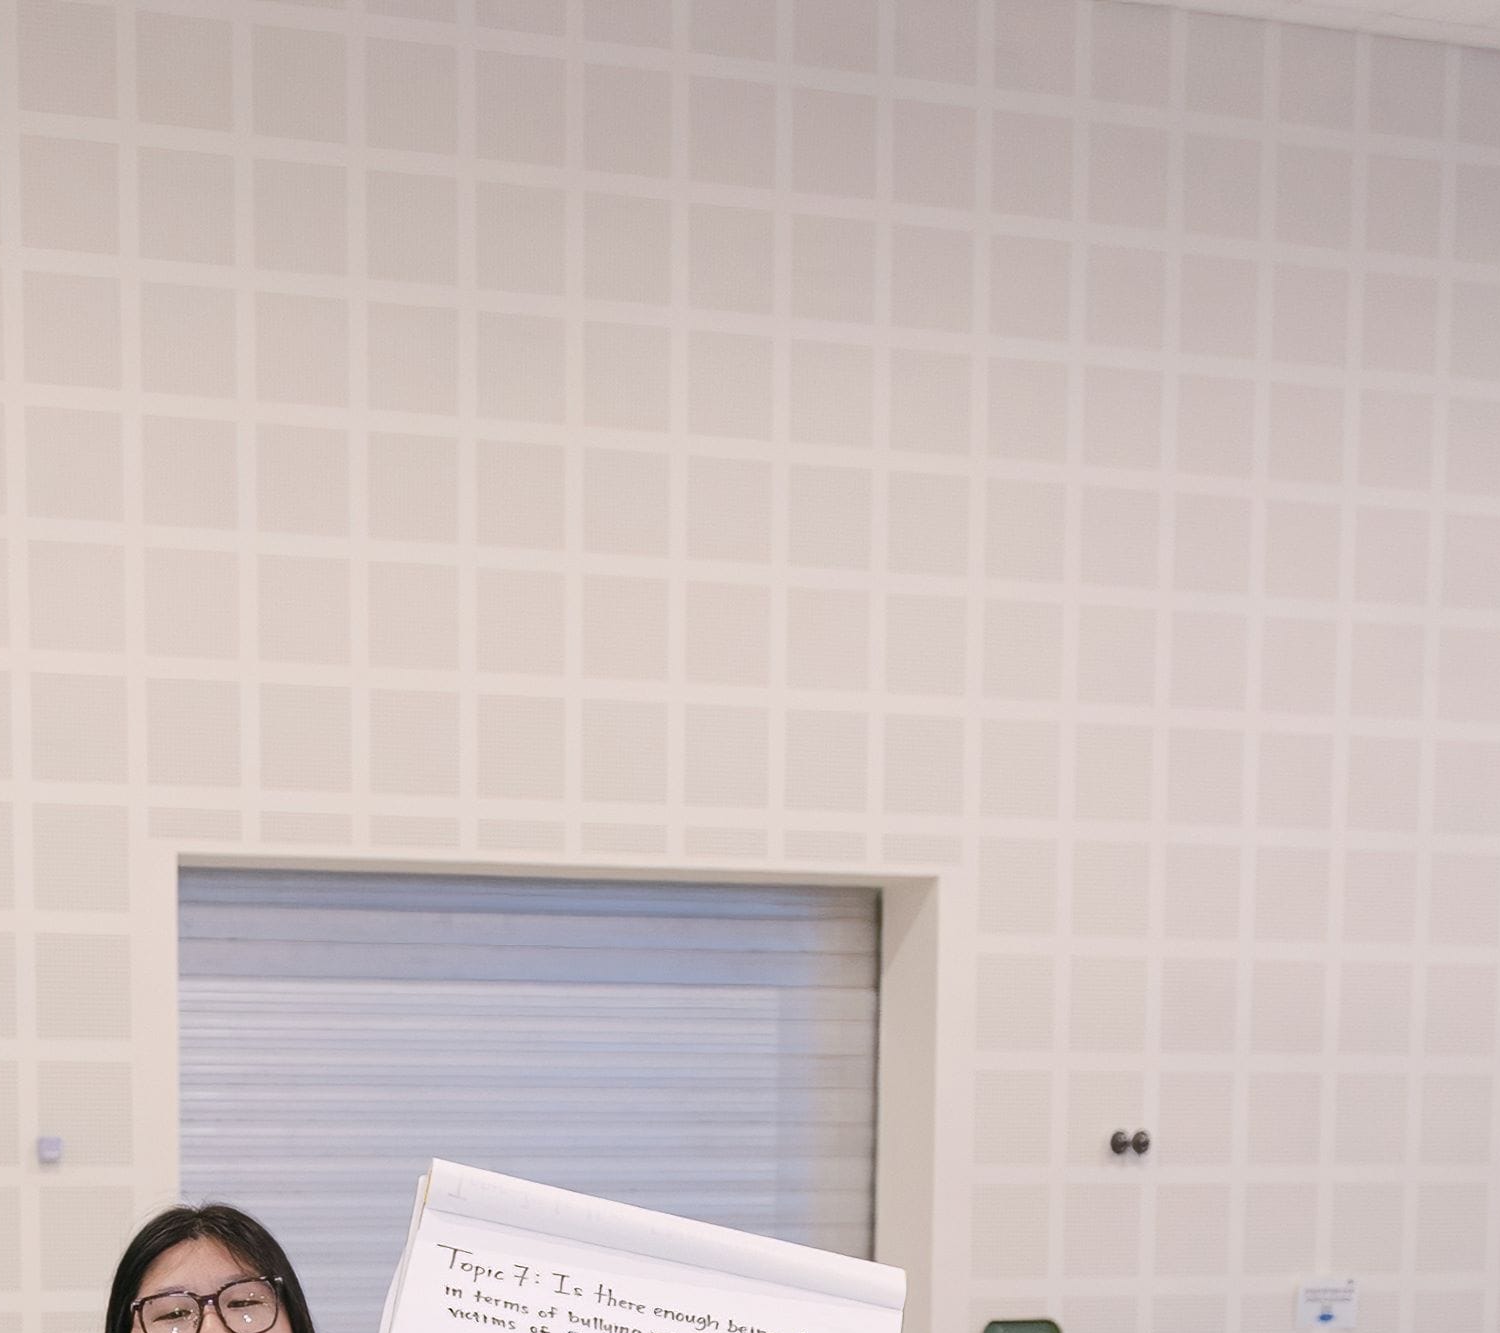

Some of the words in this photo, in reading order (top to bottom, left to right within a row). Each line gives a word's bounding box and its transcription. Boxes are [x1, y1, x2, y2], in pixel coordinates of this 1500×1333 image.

[437, 1244, 505, 1282] Topic
[514, 1264, 540, 1287] 7:
[552, 1273, 583, 1297] Is
[593, 1284, 647, 1314] there
[653, 1305, 720, 1331] enough
[445, 1285, 463, 1299] in
[474, 1290, 529, 1314] terms
[538, 1306, 558, 1318] of
[447, 1306, 517, 1331] victims
